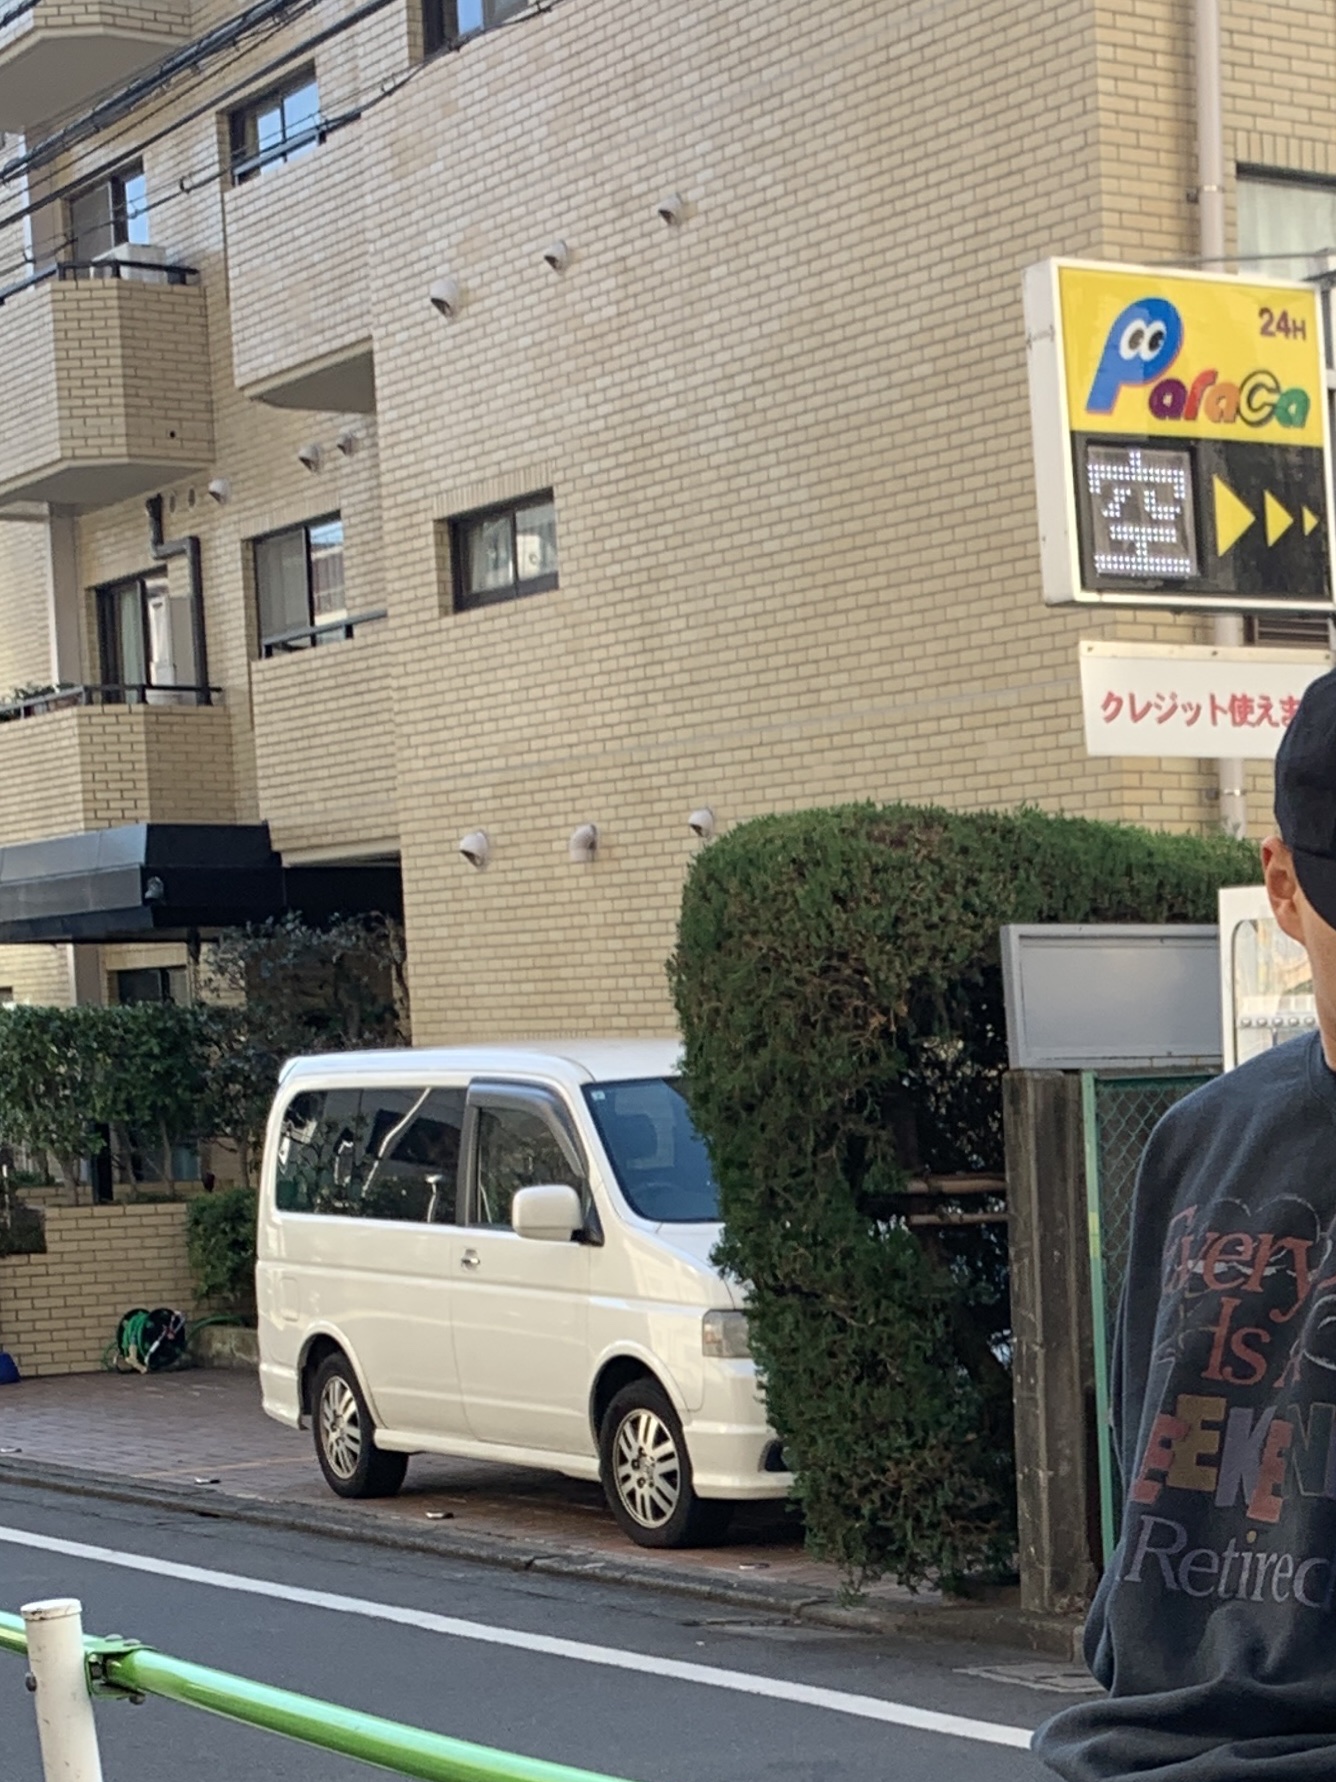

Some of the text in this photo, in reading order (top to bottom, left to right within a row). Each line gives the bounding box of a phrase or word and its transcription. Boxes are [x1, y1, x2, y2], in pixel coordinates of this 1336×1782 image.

[1259, 308, 1307, 341] 24H
[1087, 452, 1191, 574] 空
[1201, 1296, 1271, 1386] Is
